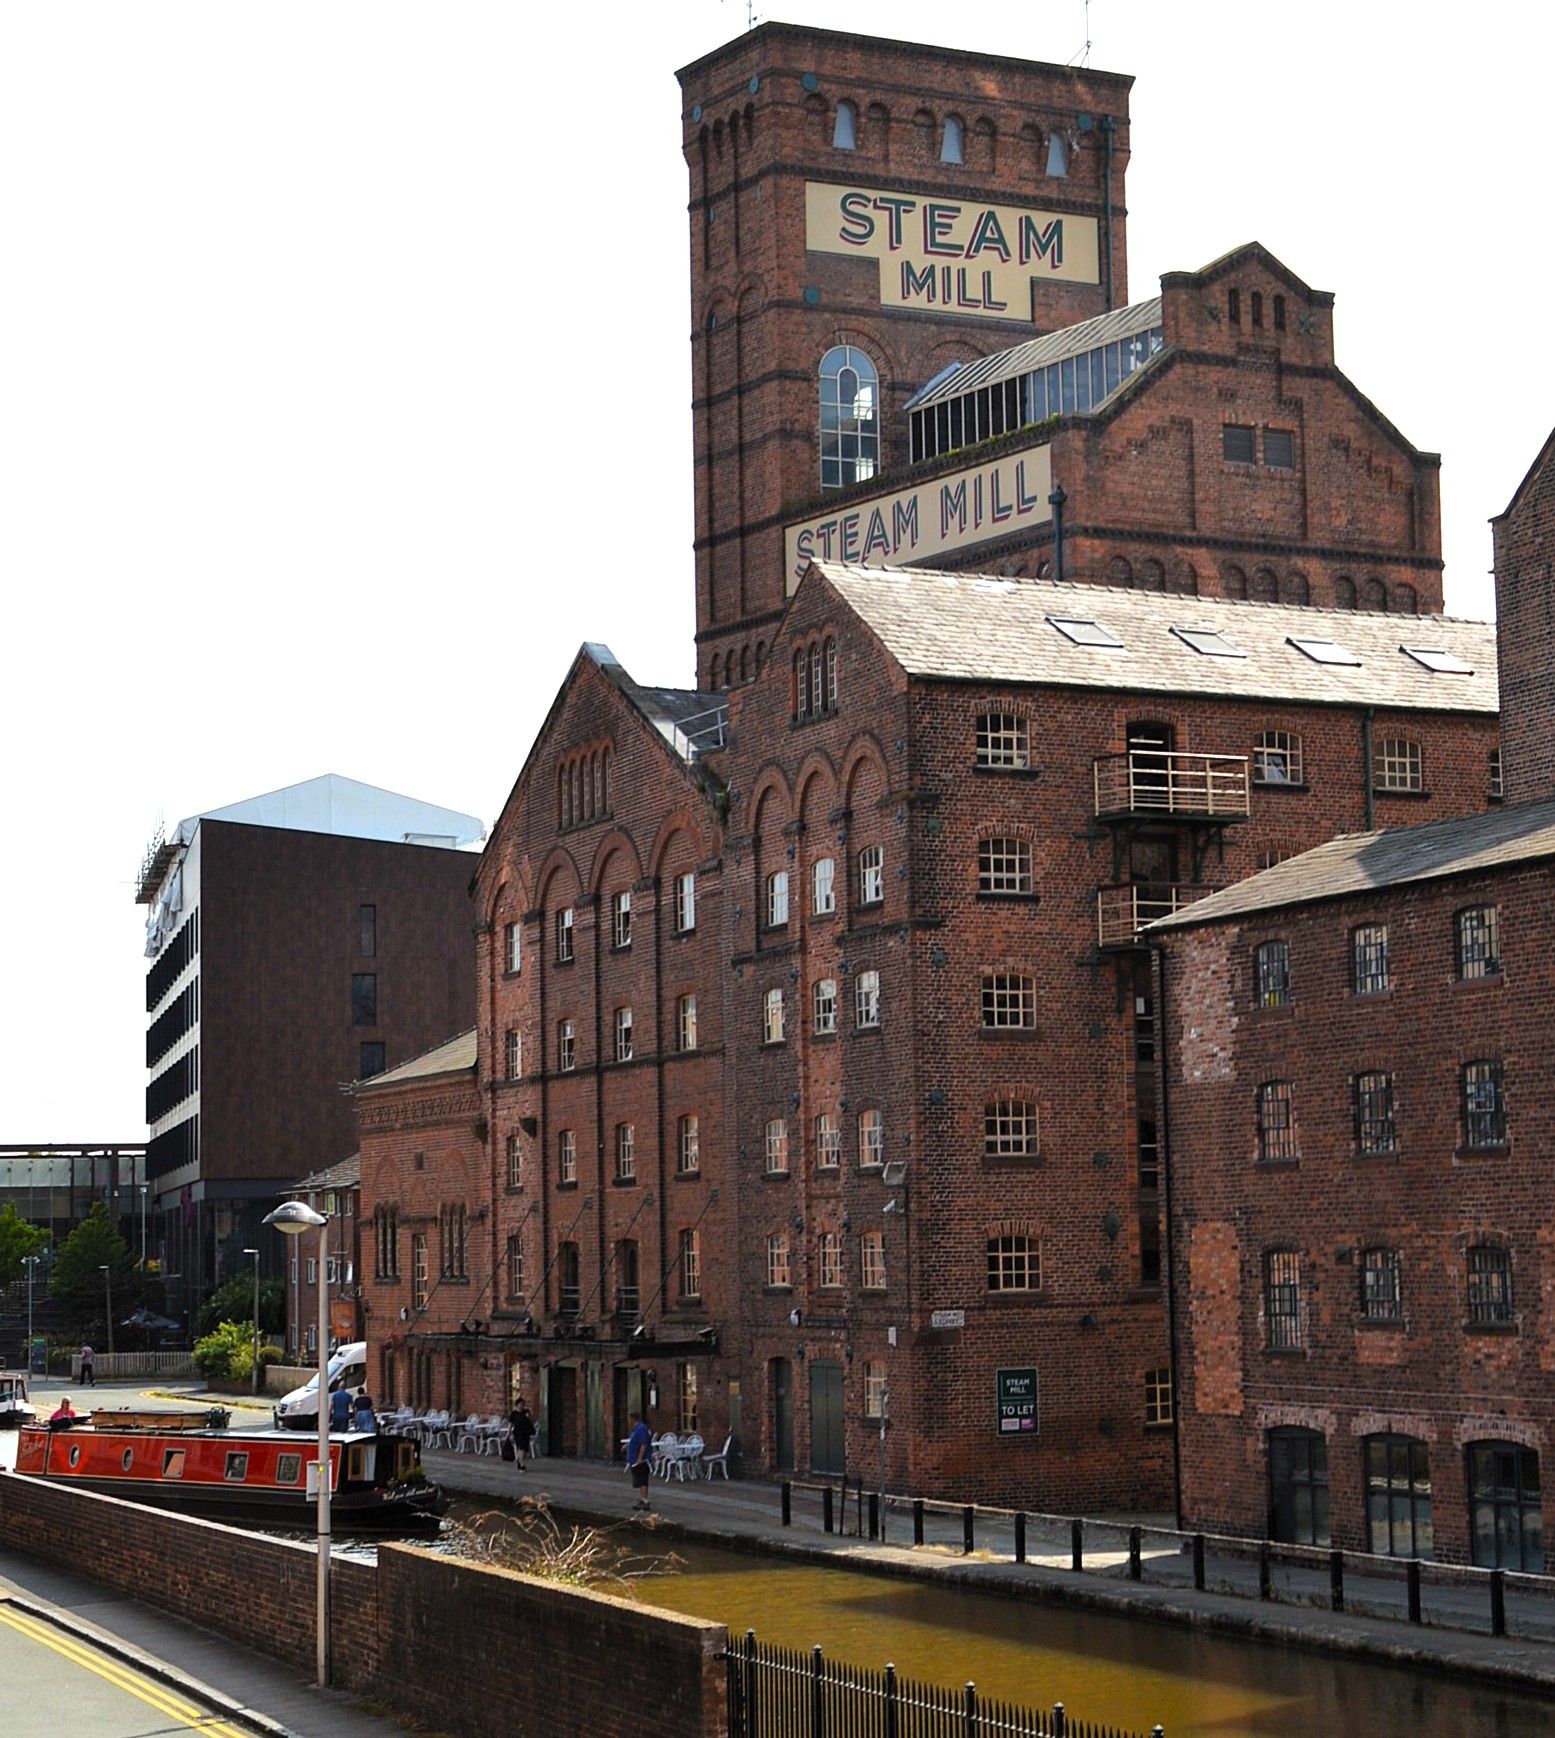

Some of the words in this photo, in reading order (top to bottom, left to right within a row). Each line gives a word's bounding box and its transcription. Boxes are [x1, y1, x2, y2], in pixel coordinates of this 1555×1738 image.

[839, 192, 1063, 269] STEAM
[901, 260, 1008, 312] MILL
[795, 495, 919, 577] STEAM
[940, 459, 1038, 539] MILL
[1006, 1378, 1030, 1386] STEAM
[1002, 1406, 1015, 1416] TO
[1018, 1404, 1034, 1415] LET
